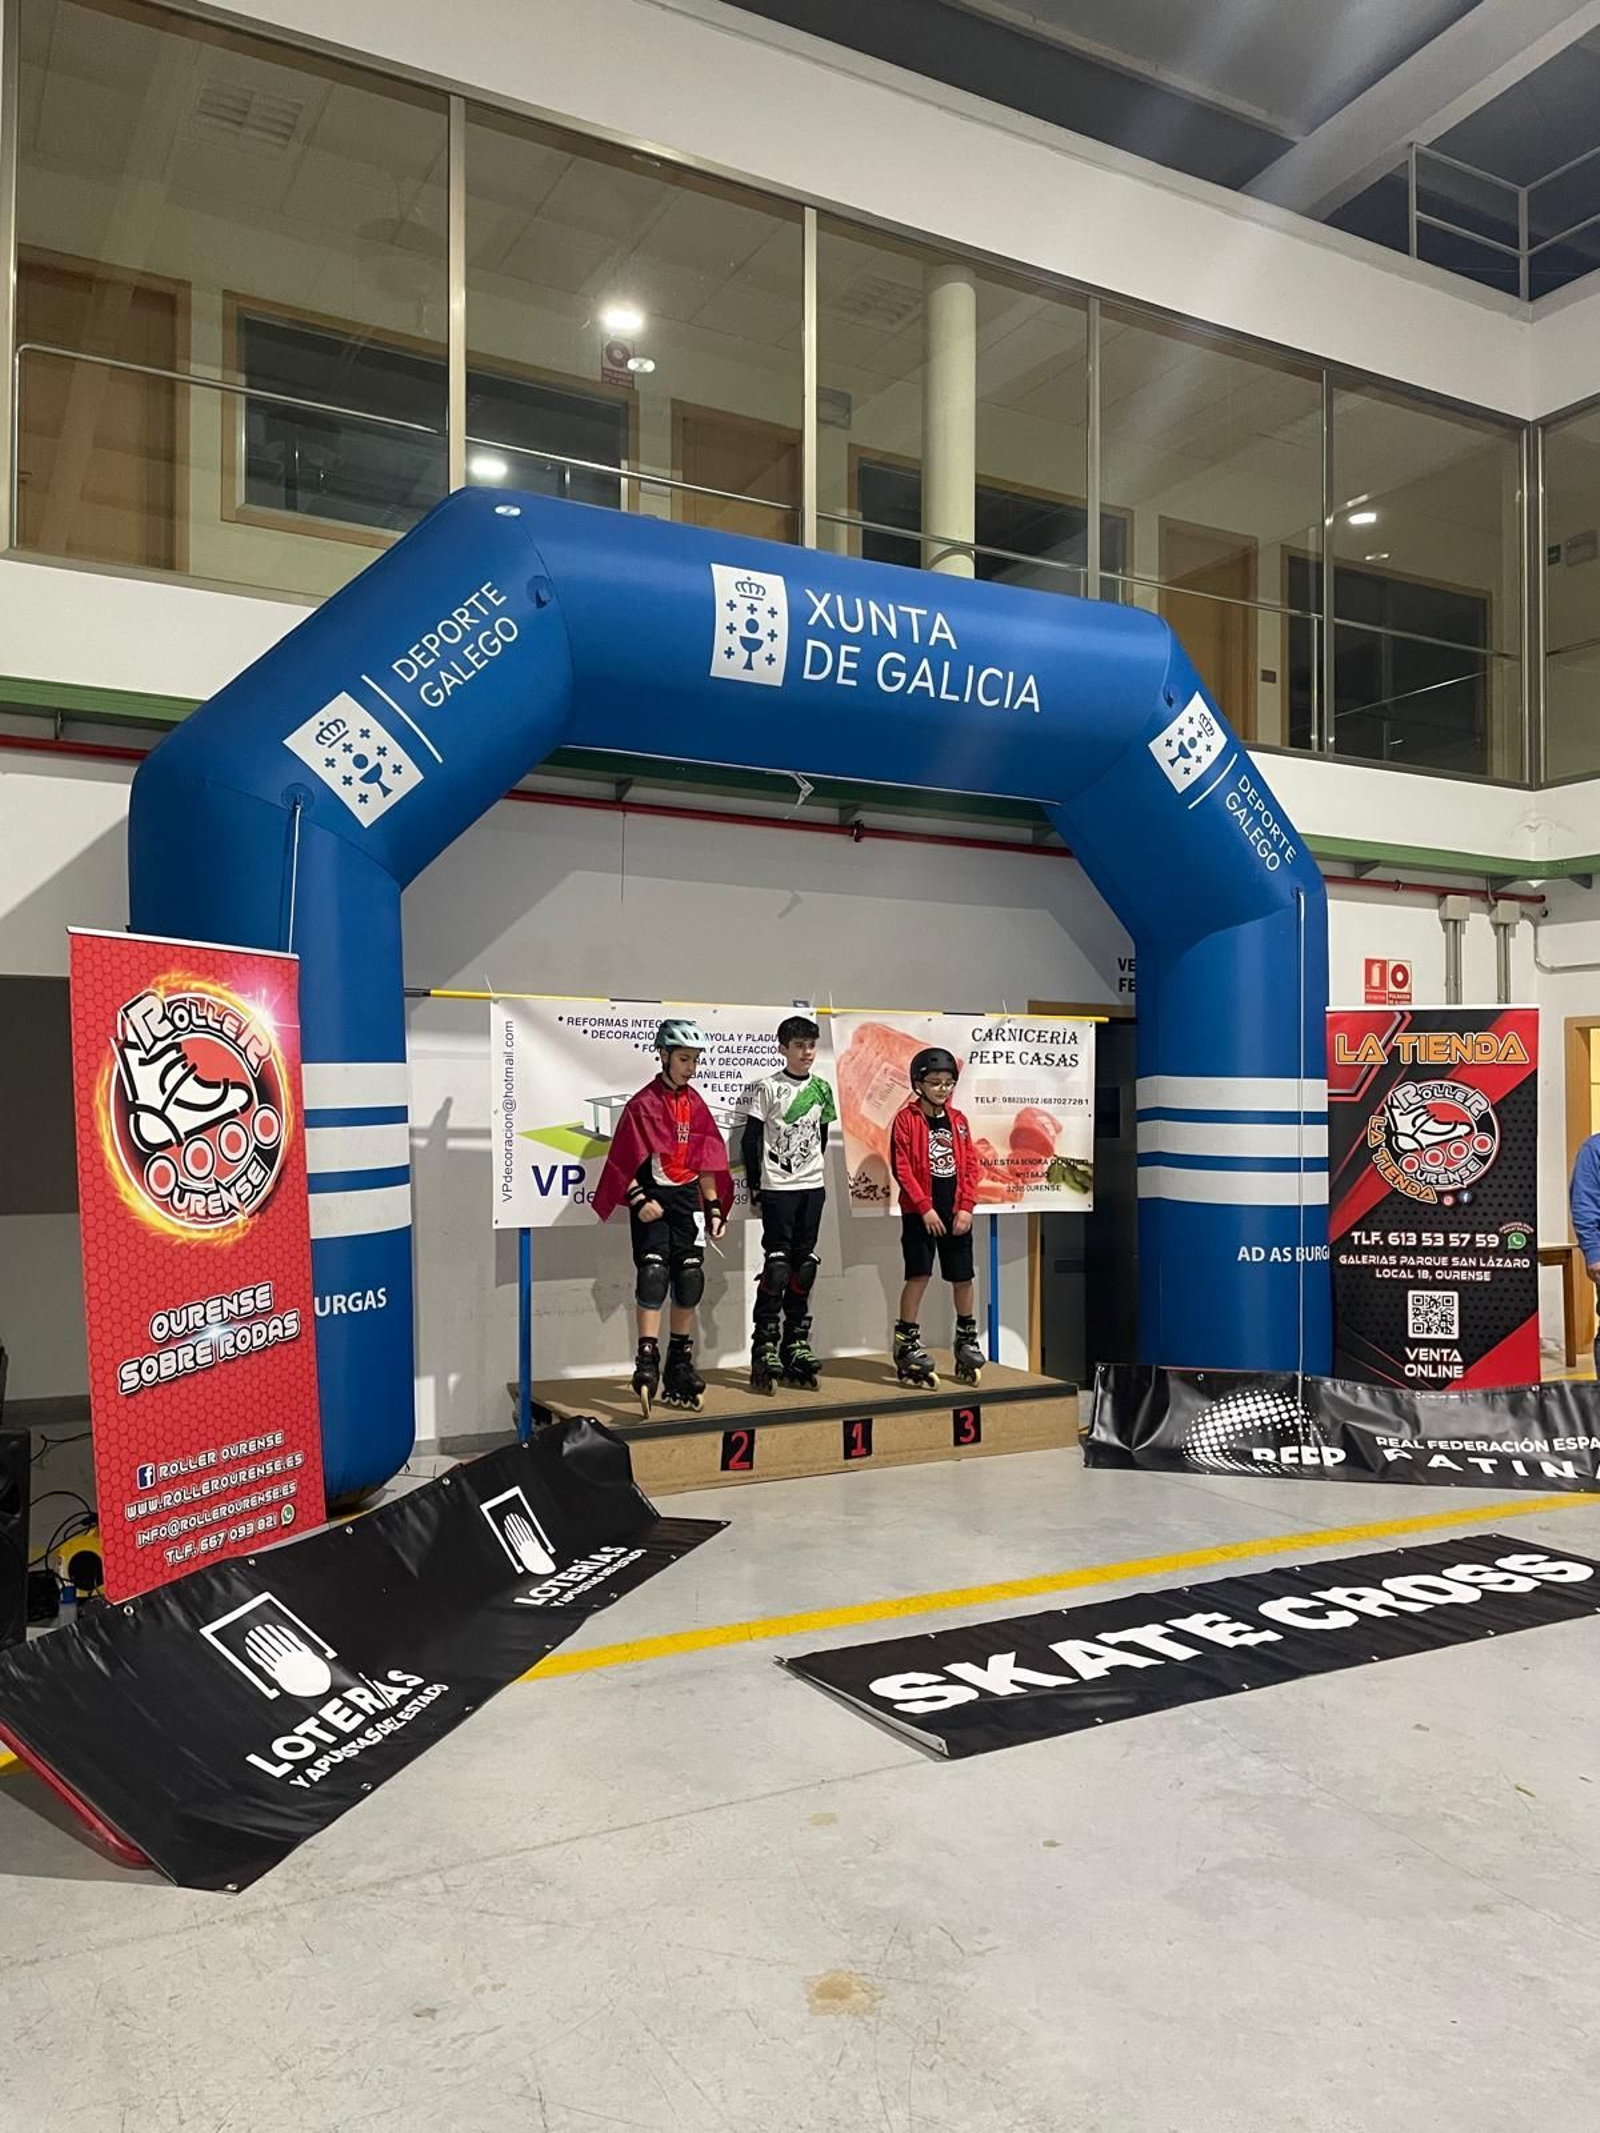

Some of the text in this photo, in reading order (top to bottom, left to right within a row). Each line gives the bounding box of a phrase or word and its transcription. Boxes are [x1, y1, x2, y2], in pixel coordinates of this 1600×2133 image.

[391, 581, 507, 683] DEPORTE
[804, 588, 958, 650] XUNTA
[419, 617, 518, 708] GALEGO
[802, 639, 1040, 713] DE GALICIA
[1225, 792, 1281, 871] GALEGO
[1238, 774, 1297, 864] DEPORTE
[1117, 957, 1136, 972] VE
[1118, 977, 1136, 993] FE
[121, 990, 272, 1076] ROLLER
[566, 1017, 628, 1028] REFORMAS
[591, 1029, 657, 1041] DECORACIÓ
[746, 1033, 779, 1042] PLADU
[717, 1044, 778, 1054] CALEFACCIÓ
[969, 1050, 1079, 1067] PEPE CASAS
[1336, 1032, 1529, 1064] LA TIENDA
[501, 1020, 517, 1203] VPdecoracion@hotmail.com
[1391, 1082, 1490, 1120] ROLLER
[1368, 1116, 1387, 1148] LA
[531, 1165, 586, 1197] VP
[1372, 1147, 1437, 1204] TIENDA
[1237, 1244, 1330, 1263] AD AS BURG
[1351, 1231, 1500, 1248] TLF. 613 53 57 59
[1339, 1254, 1397, 1266] GALERIAS
[1400, 1255, 1449, 1267] PARQUE
[1451, 1256, 1477, 1268] SAN
[1375, 1268, 1415, 1280] LOCAL
[1435, 1270, 1492, 1282] OURENSE
[151, 1282, 272, 1342] OURENSE
[314, 1287, 387, 1317] URGAS
[119, 1310, 300, 1394] SOBRE RODAS
[1404, 1347, 1463, 1362] VENTA
[1404, 1363, 1464, 1379] ONLINE
[851, 1422, 867, 1457] 1
[959, 1409, 976, 1444] 3
[158, 1452, 217, 1480] ROLLER
[221, 1431, 284, 1461] OURENSE
[728, 1430, 751, 1471] 2
[1375, 1436, 1600, 1453] REAL FEDERACIÓN ESPA
[137, 1481, 298, 1548] INFO@ROLLEROURENSE.ES
[867, 1552, 1596, 1715] SKATE CROSS
[289, 1775, 311, 1789] Y
